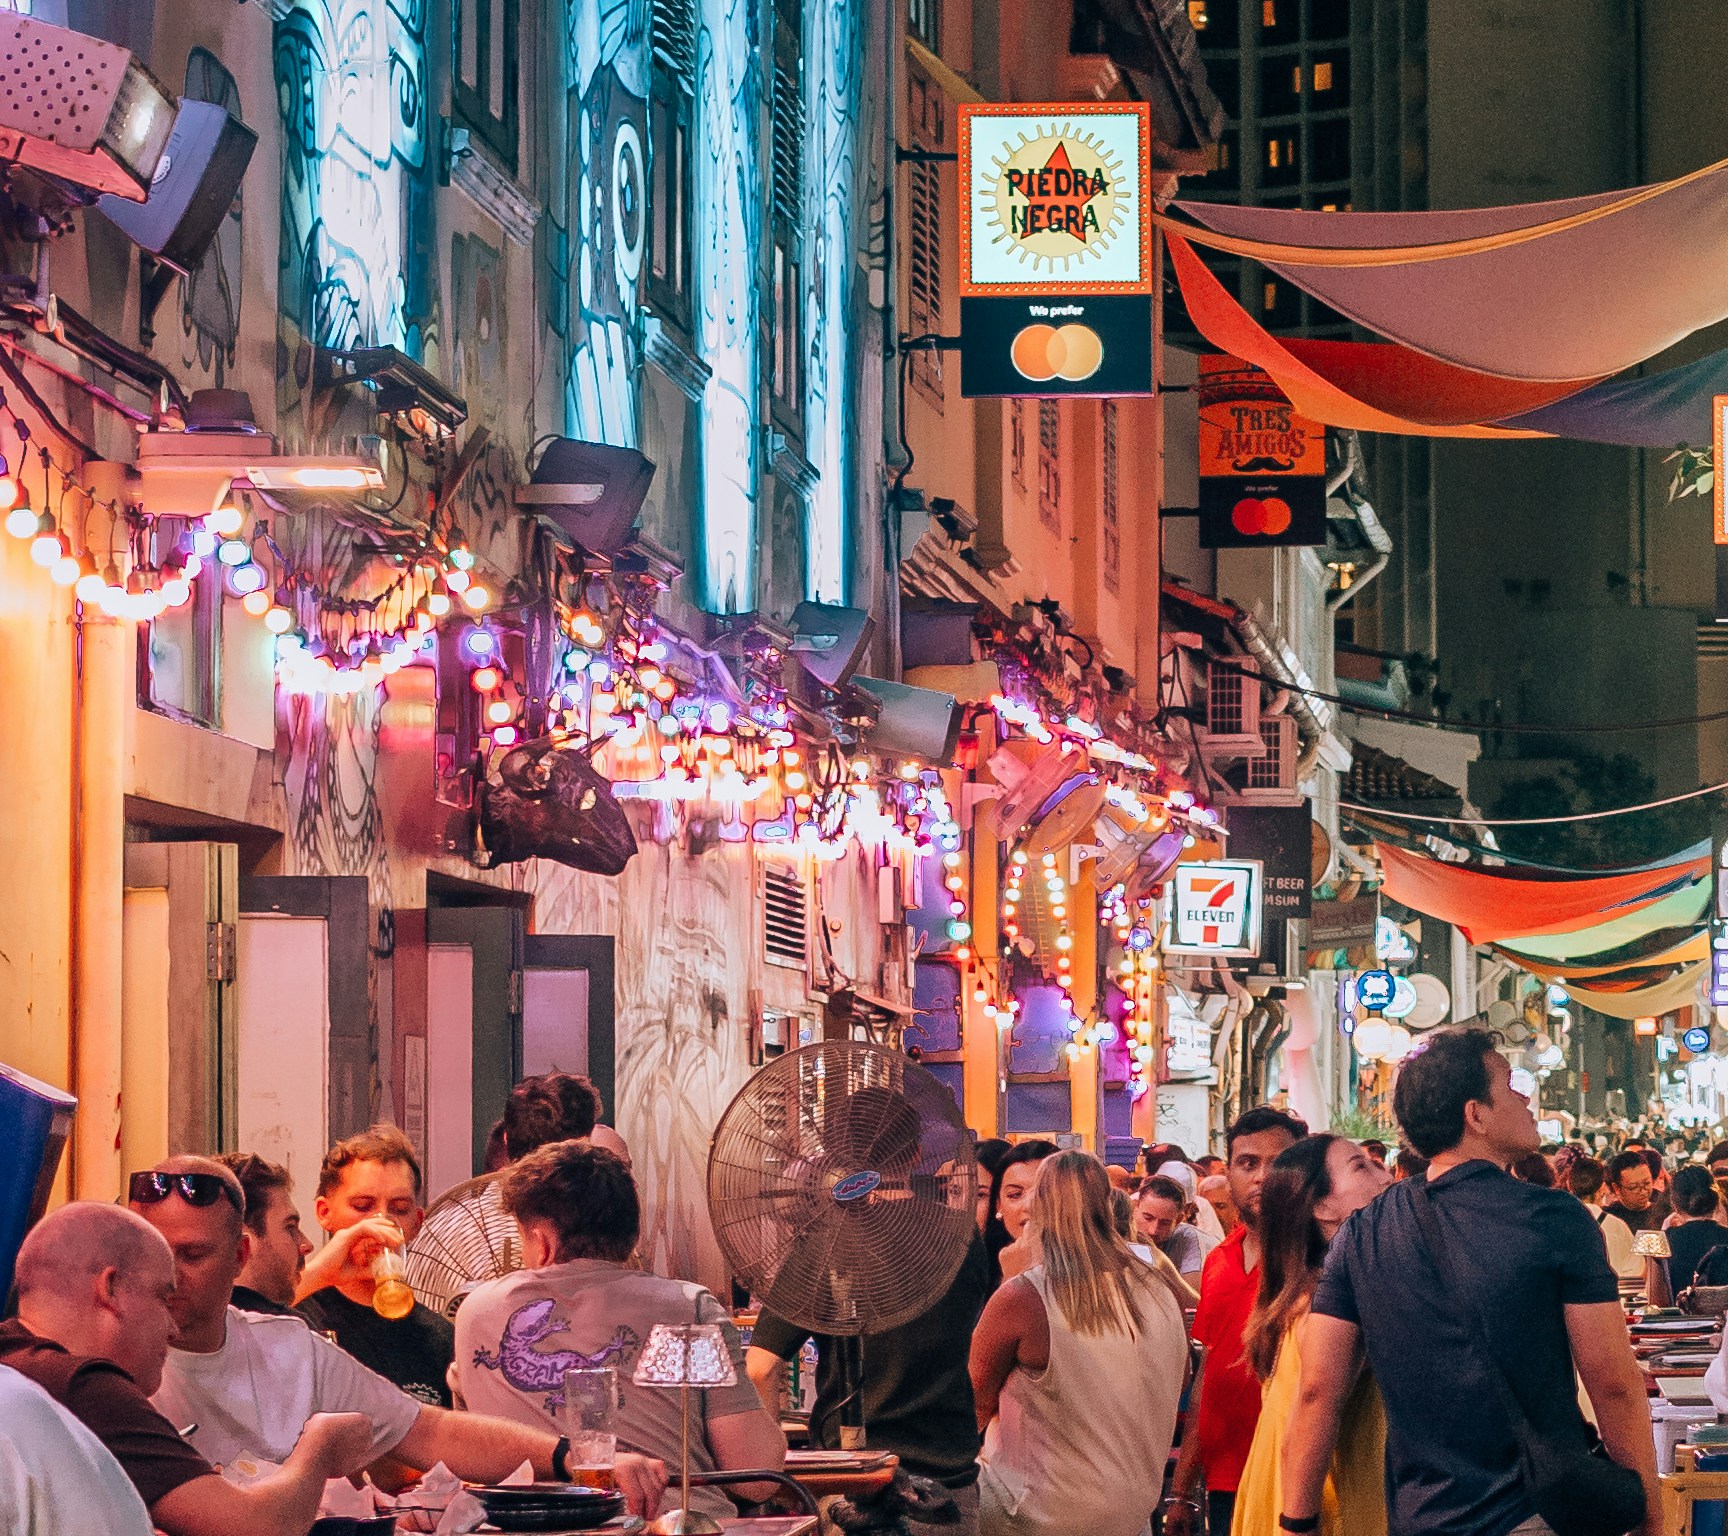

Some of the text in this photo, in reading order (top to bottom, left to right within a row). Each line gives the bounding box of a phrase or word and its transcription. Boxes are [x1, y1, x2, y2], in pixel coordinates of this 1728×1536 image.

[1008, 167, 1108, 197] PIEDRA
[1011, 204, 1100, 234] NEGRA
[1029, 304, 1085, 318] We prefer
[1230, 407, 1293, 433] TRES
[1215, 428, 1306, 460] AMIGOS
[1190, 878, 1235, 907] 7
[1277, 877, 1305, 890] BEER
